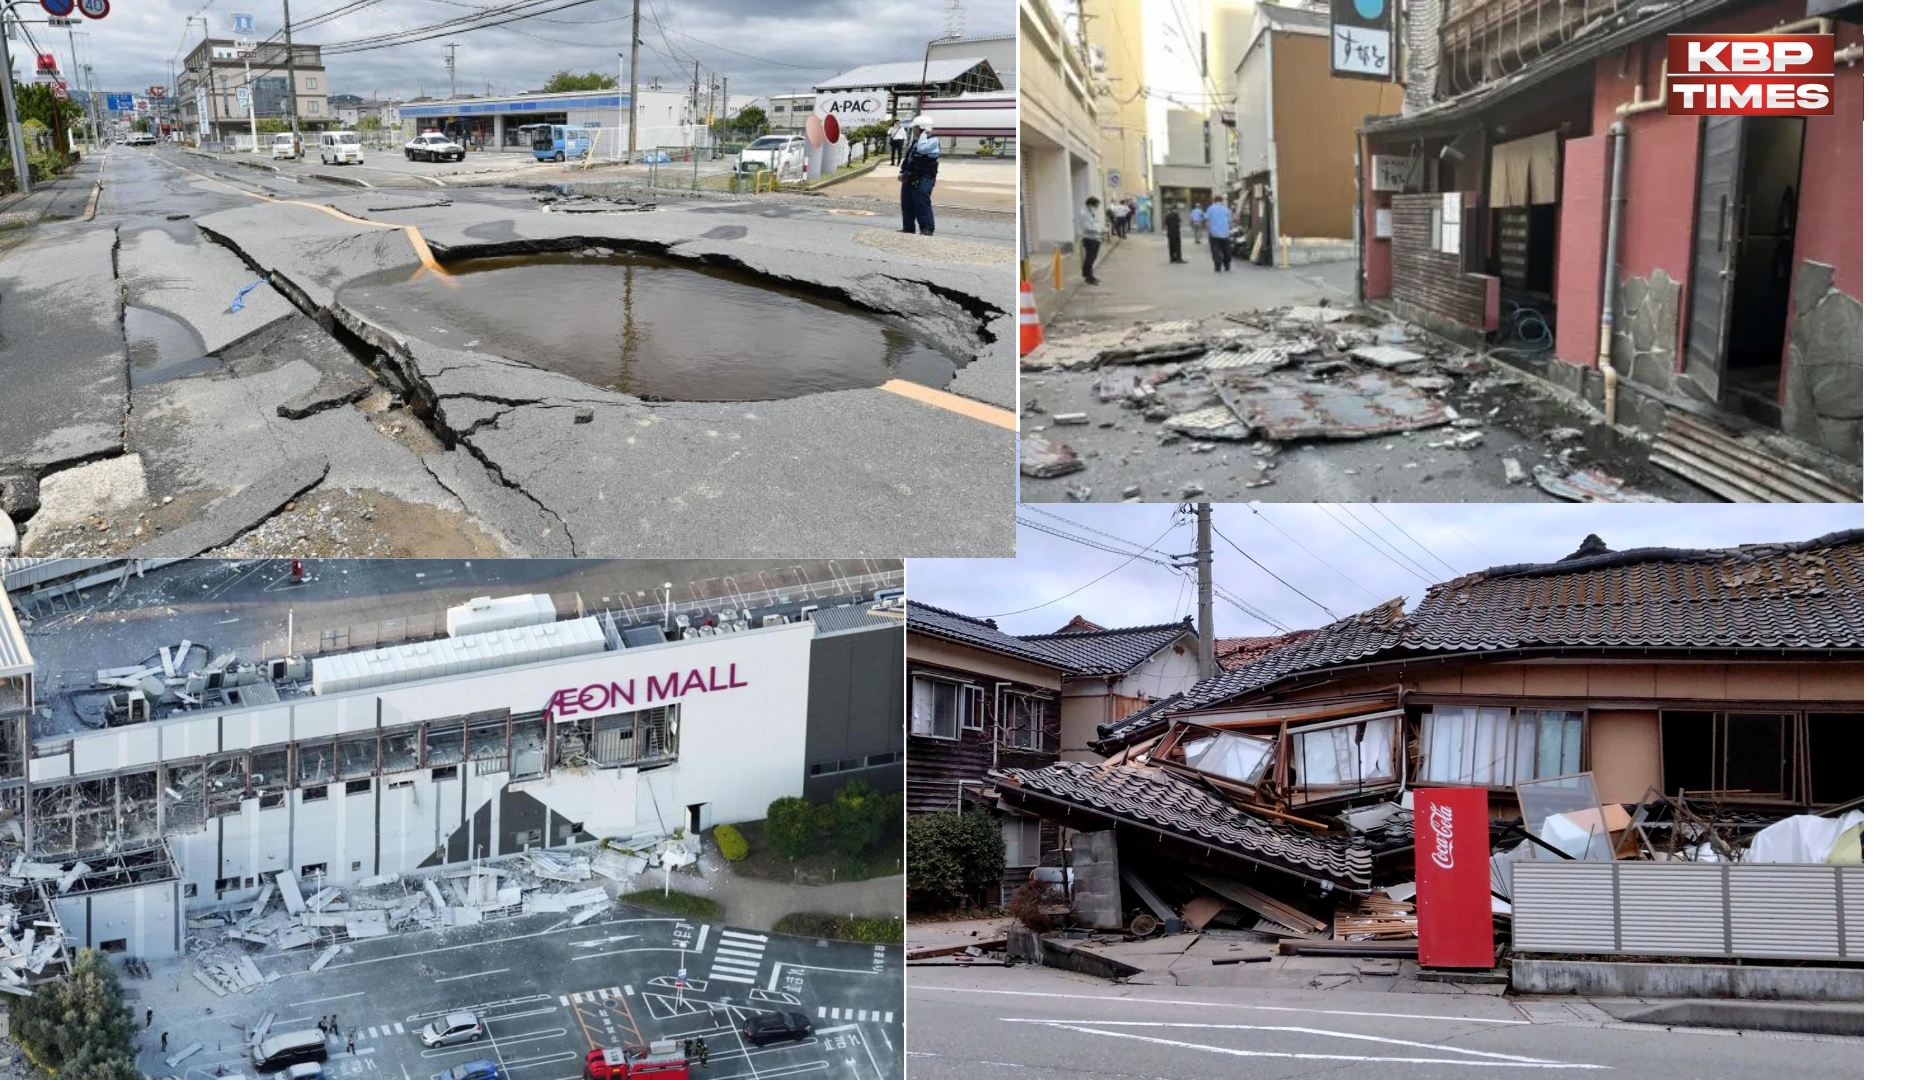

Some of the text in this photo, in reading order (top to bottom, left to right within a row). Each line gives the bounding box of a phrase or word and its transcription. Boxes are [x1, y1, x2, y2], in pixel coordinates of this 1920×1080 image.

[85, 0, 103, 11] 40
[647, 663, 748, 702] MALL
[782, 968, 806, 994] 止まれ
[823, 1033, 861, 1051] 止まれ
